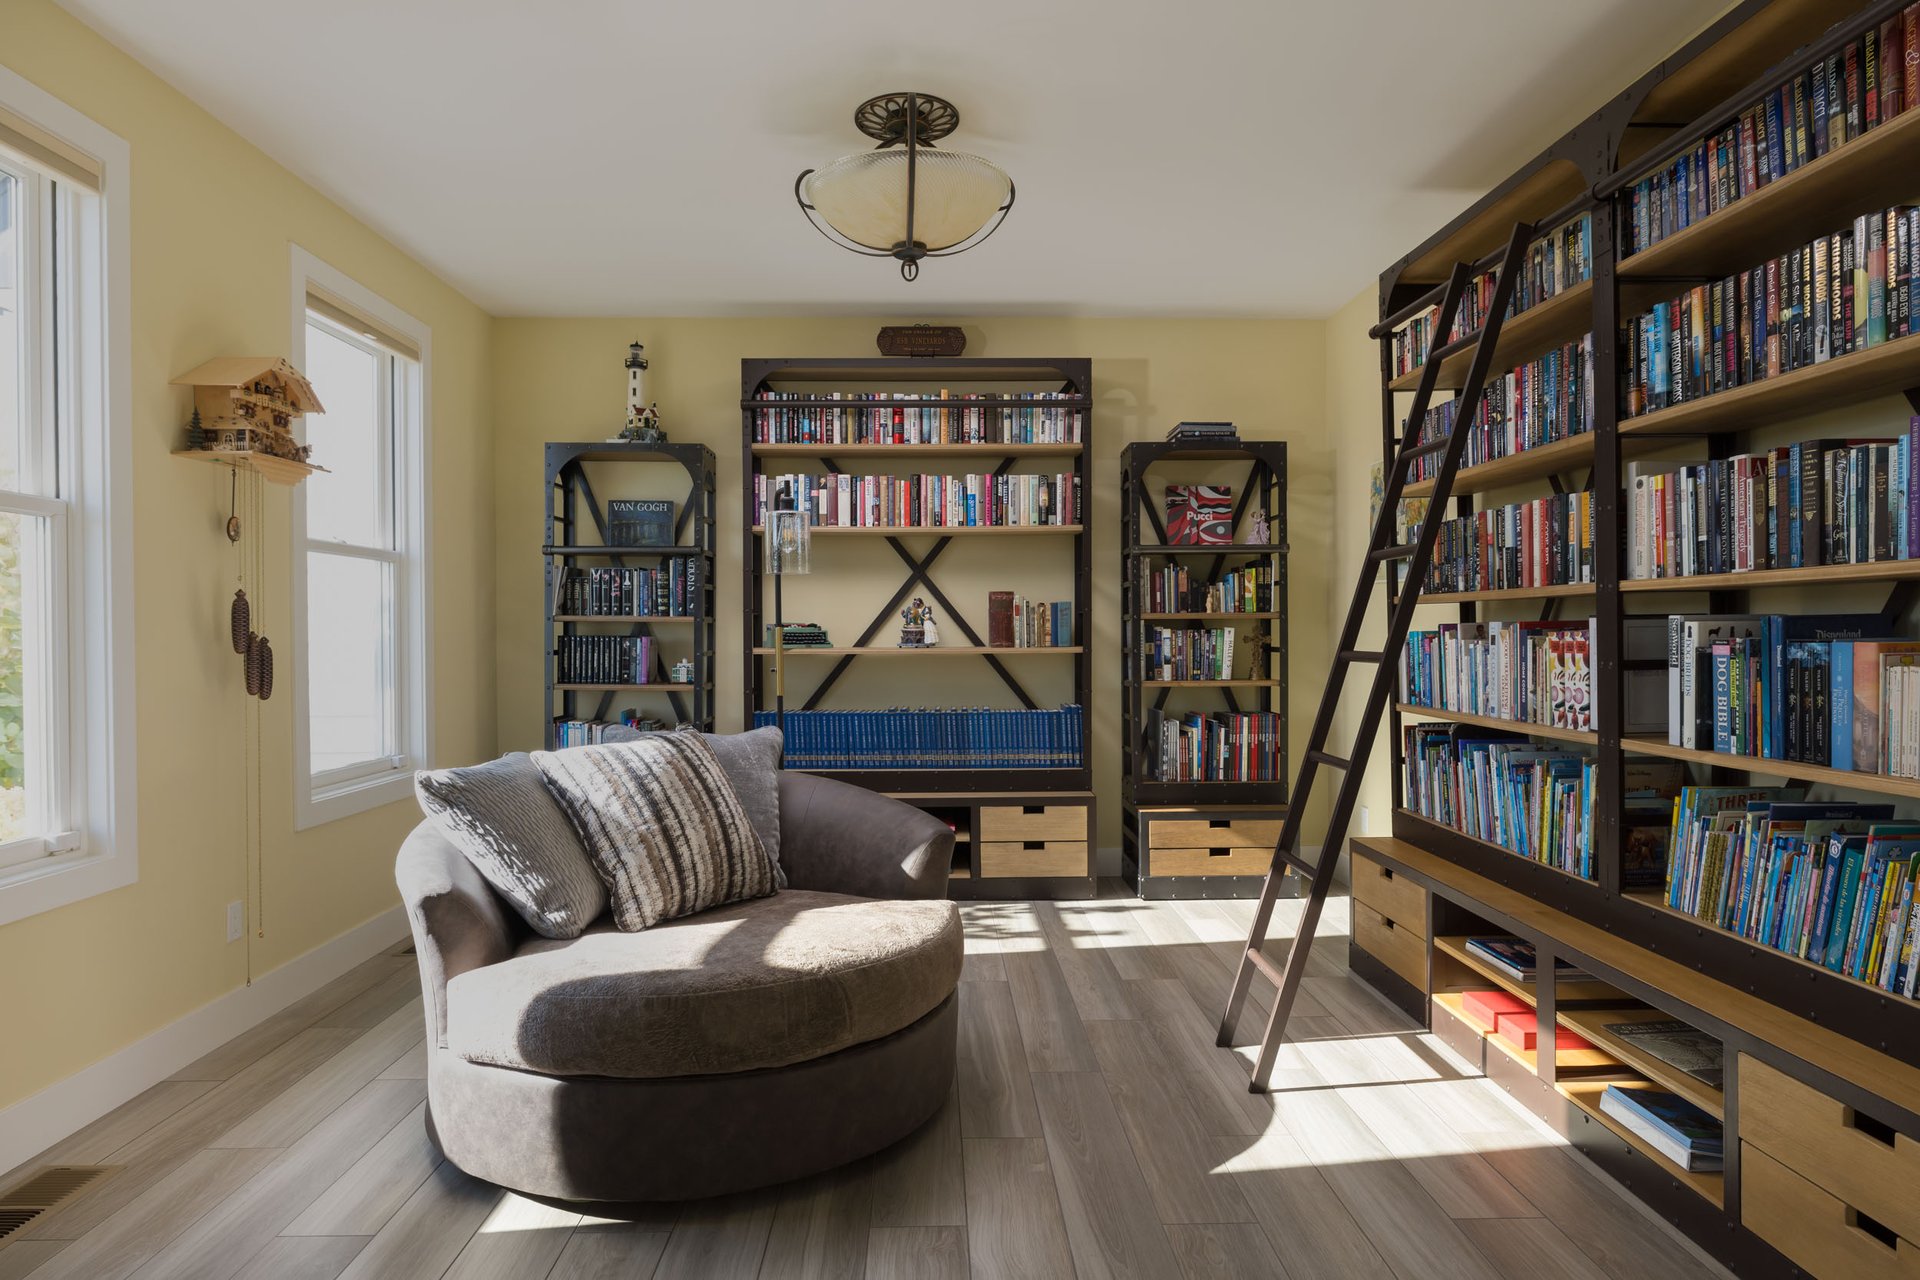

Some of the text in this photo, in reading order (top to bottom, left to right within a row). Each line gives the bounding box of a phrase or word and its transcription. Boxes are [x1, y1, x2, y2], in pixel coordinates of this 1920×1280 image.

[1866, 46, 1876, 90] BALDACCI
[1887, 211, 1896, 250] STUART
[1792, 254, 1800, 284] Daniel
[1832, 235, 1841, 277] STUART
[1887, 250, 1896, 290] WOODS
[1910, 246, 1920, 279] WOODS
[1754, 270, 1762, 299] Daniel
[1780, 258, 1788, 288] Daniel
[1816, 240, 1827, 304] STUART WOODS
[1754, 300, 1762, 320] Silva
[1780, 289, 1788, 309] Silva
[1792, 284, 1800, 306] Silva
[1832, 278, 1841, 321] WOODS
[912, 336, 946, 344] VINEYARDS
[1672, 379, 1682, 402] GROSS
[1912, 422, 1920, 450] DEBBIE
[1912, 451, 1920, 492] MACOMBER
[613, 502, 668, 512] VAN GOGH
[1186, 511, 1213, 522] Pucci
[1738, 476, 1747, 553] American Tragedy
[1670, 618, 1679, 666] SeaWorld
[1684, 638, 1692, 697] DOG BREEDS
[1716, 656, 1728, 742] DOG BIBLE
[1717, 792, 1767, 810] THREE
[1842, 867, 1854, 888] tesoro
[1842, 889, 1848, 898] de
[1834, 908, 1844, 936] virtudes
